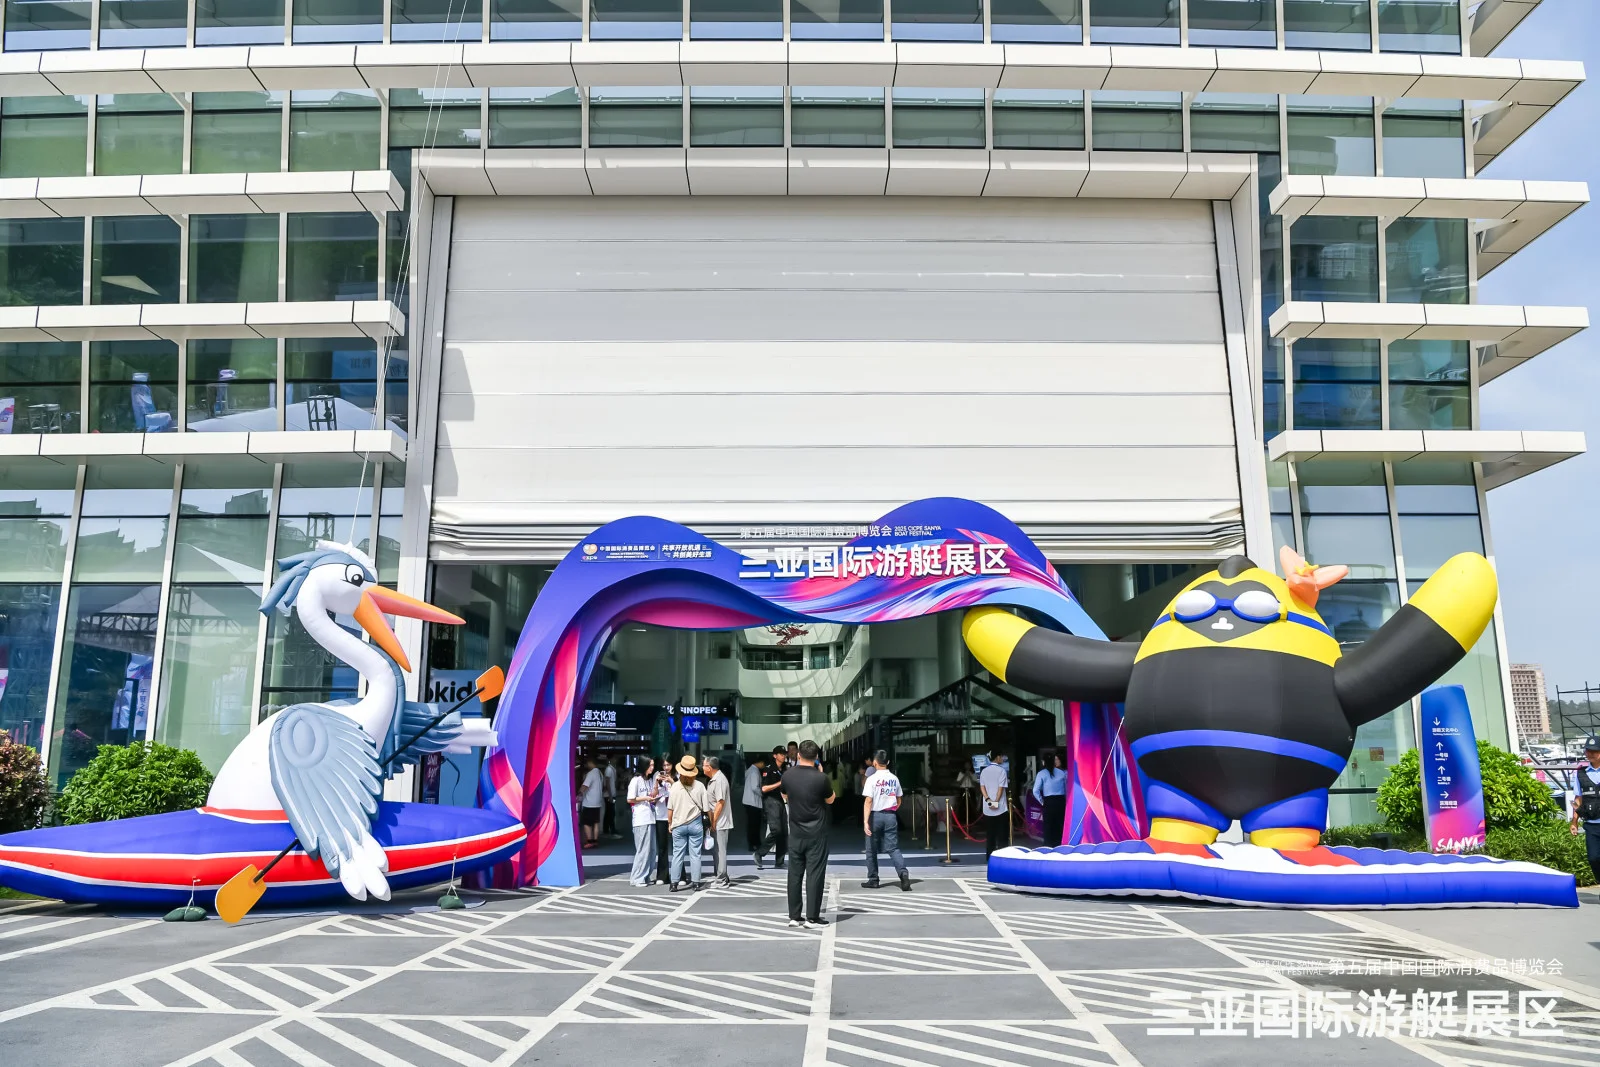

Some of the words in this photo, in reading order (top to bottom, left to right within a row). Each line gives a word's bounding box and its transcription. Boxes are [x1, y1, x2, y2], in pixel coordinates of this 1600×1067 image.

[740, 525, 892, 539] 第五届中国国际消费品博览会
[739, 543, 1011, 578] 三亚国际游艇展区
[1435, 836, 1479, 852] SANYA
